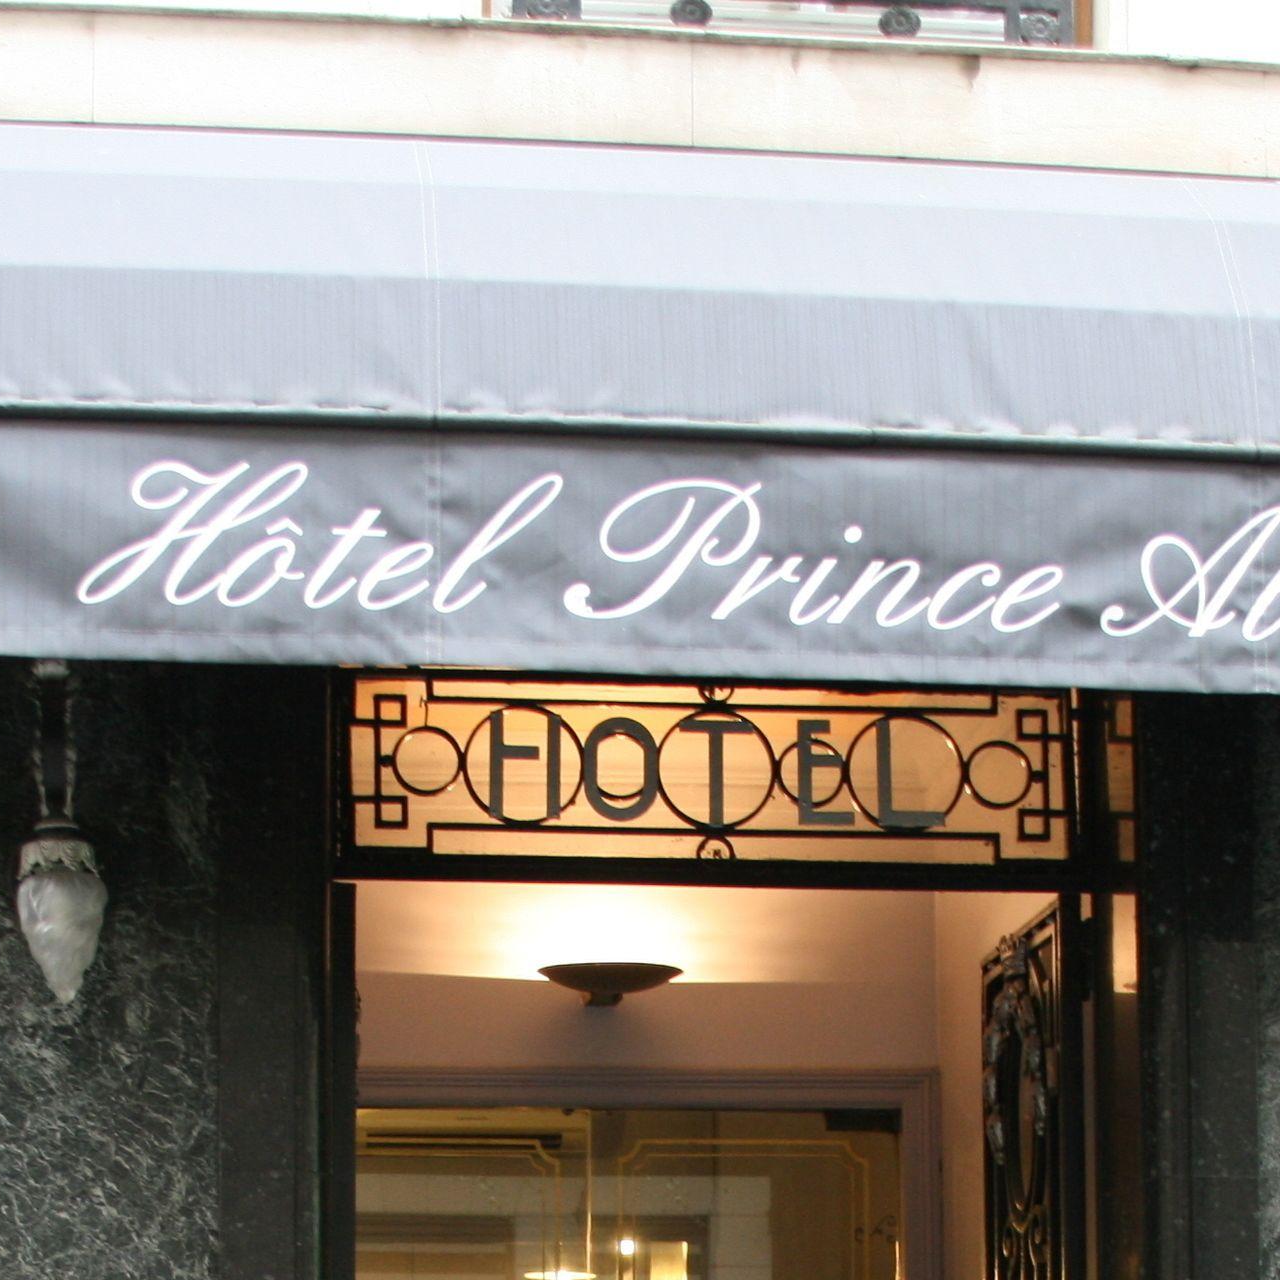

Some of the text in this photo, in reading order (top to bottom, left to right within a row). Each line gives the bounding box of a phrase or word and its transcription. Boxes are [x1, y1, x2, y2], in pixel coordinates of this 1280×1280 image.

[76, 460, 563, 614] Hôtel
[563, 478, 1064, 634] Prince
[488, 708, 947, 829] HOTEL
